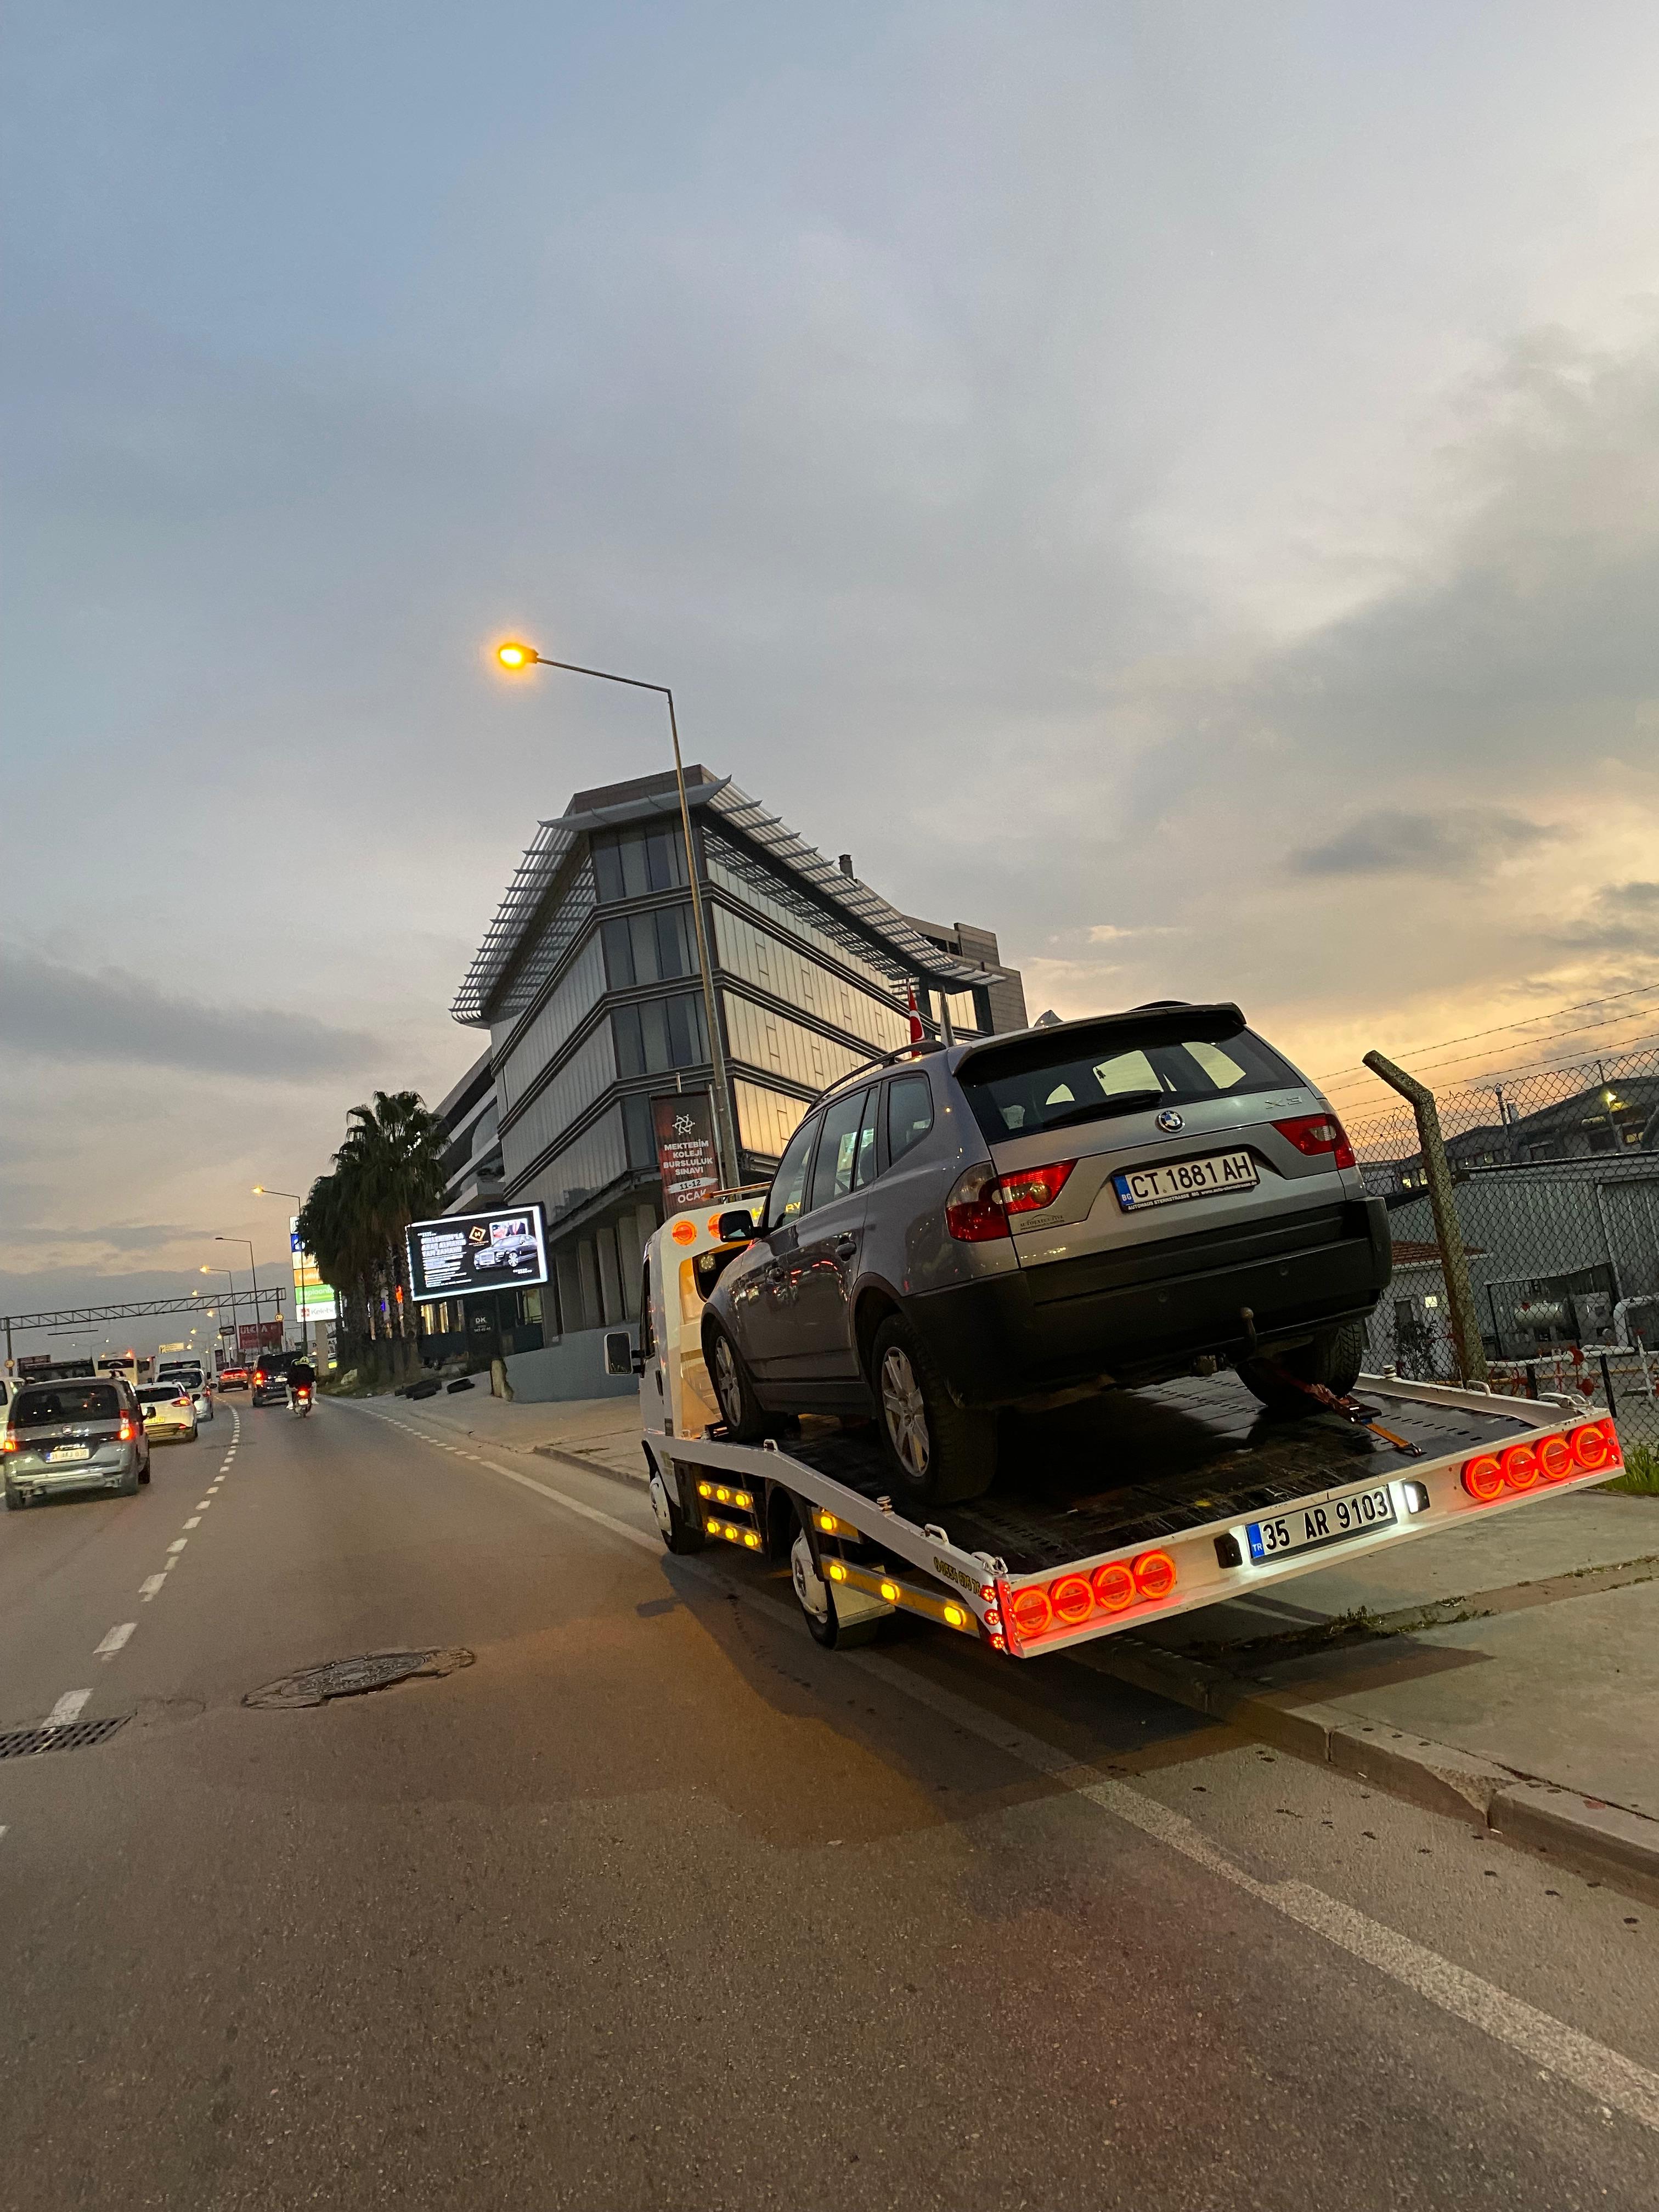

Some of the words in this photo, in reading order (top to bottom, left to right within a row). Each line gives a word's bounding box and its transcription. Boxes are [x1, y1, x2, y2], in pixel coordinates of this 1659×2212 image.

[1265, 1096, 1303, 1110] X3
[664, 1139, 709, 1151] MEKTEBİM
[673, 1148, 703, 1159] KOLEJİ
[663, 1157, 713, 1169] BURSLULUK
[675, 1166, 704, 1176] SINAVI
[1131, 1172, 1160, 1198] CT
[1166, 1161, 1218, 1190] 1881
[1223, 1155, 1252, 1181] AH
[680, 1180, 701, 1190] 11-12
[1121, 1193, 1132, 1201] BG
[1263, 1519, 1290, 1550] 35
[1304, 1509, 1330, 1539] AR
[1336, 1491, 1388, 1528] 9103
[1252, 1543, 1263, 1552] TR
